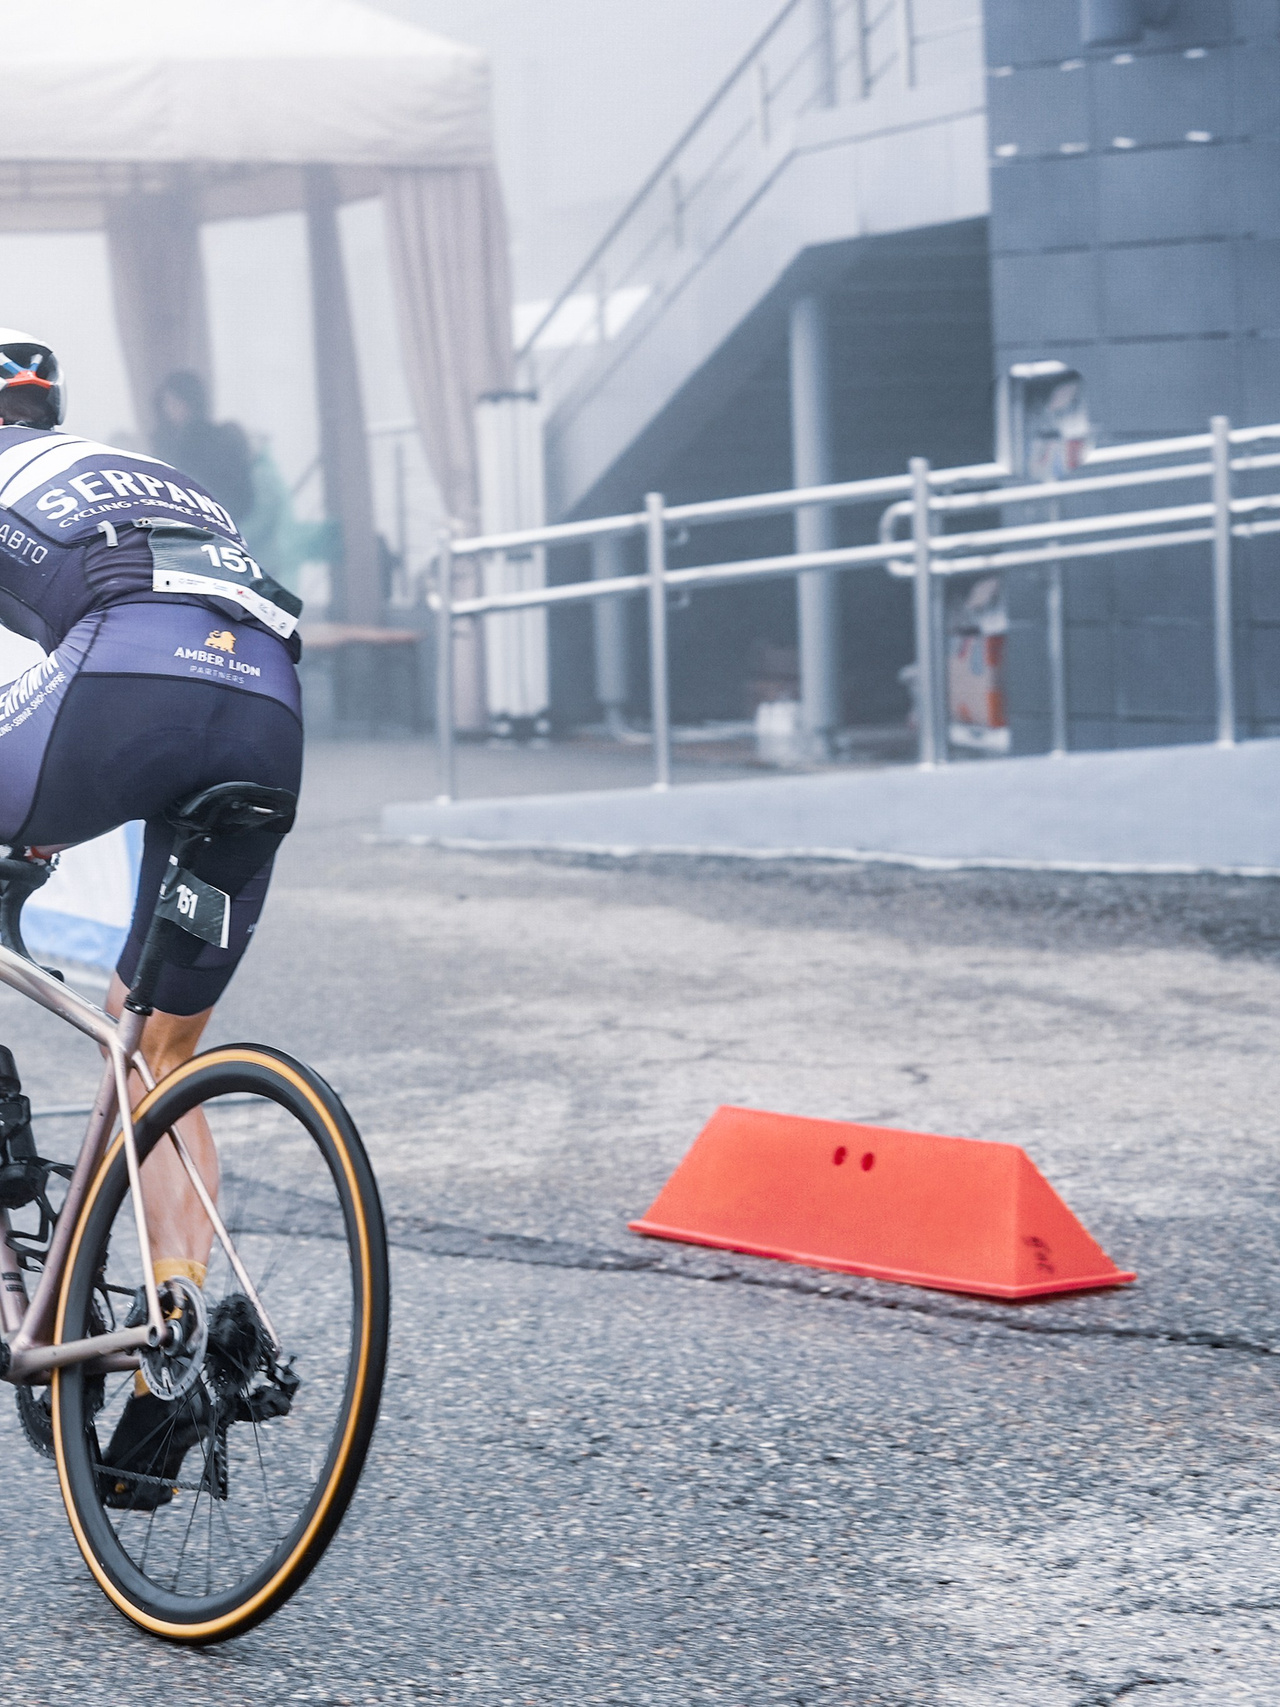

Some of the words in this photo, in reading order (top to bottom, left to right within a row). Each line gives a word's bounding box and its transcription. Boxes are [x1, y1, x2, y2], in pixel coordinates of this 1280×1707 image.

[58, 501, 132, 528] CYCLING
[200, 543, 263, 579] 151
[174, 647, 224, 667] AMBER
[229, 659, 261, 677] LION
[190, 666, 245, 684] PARTNERS
